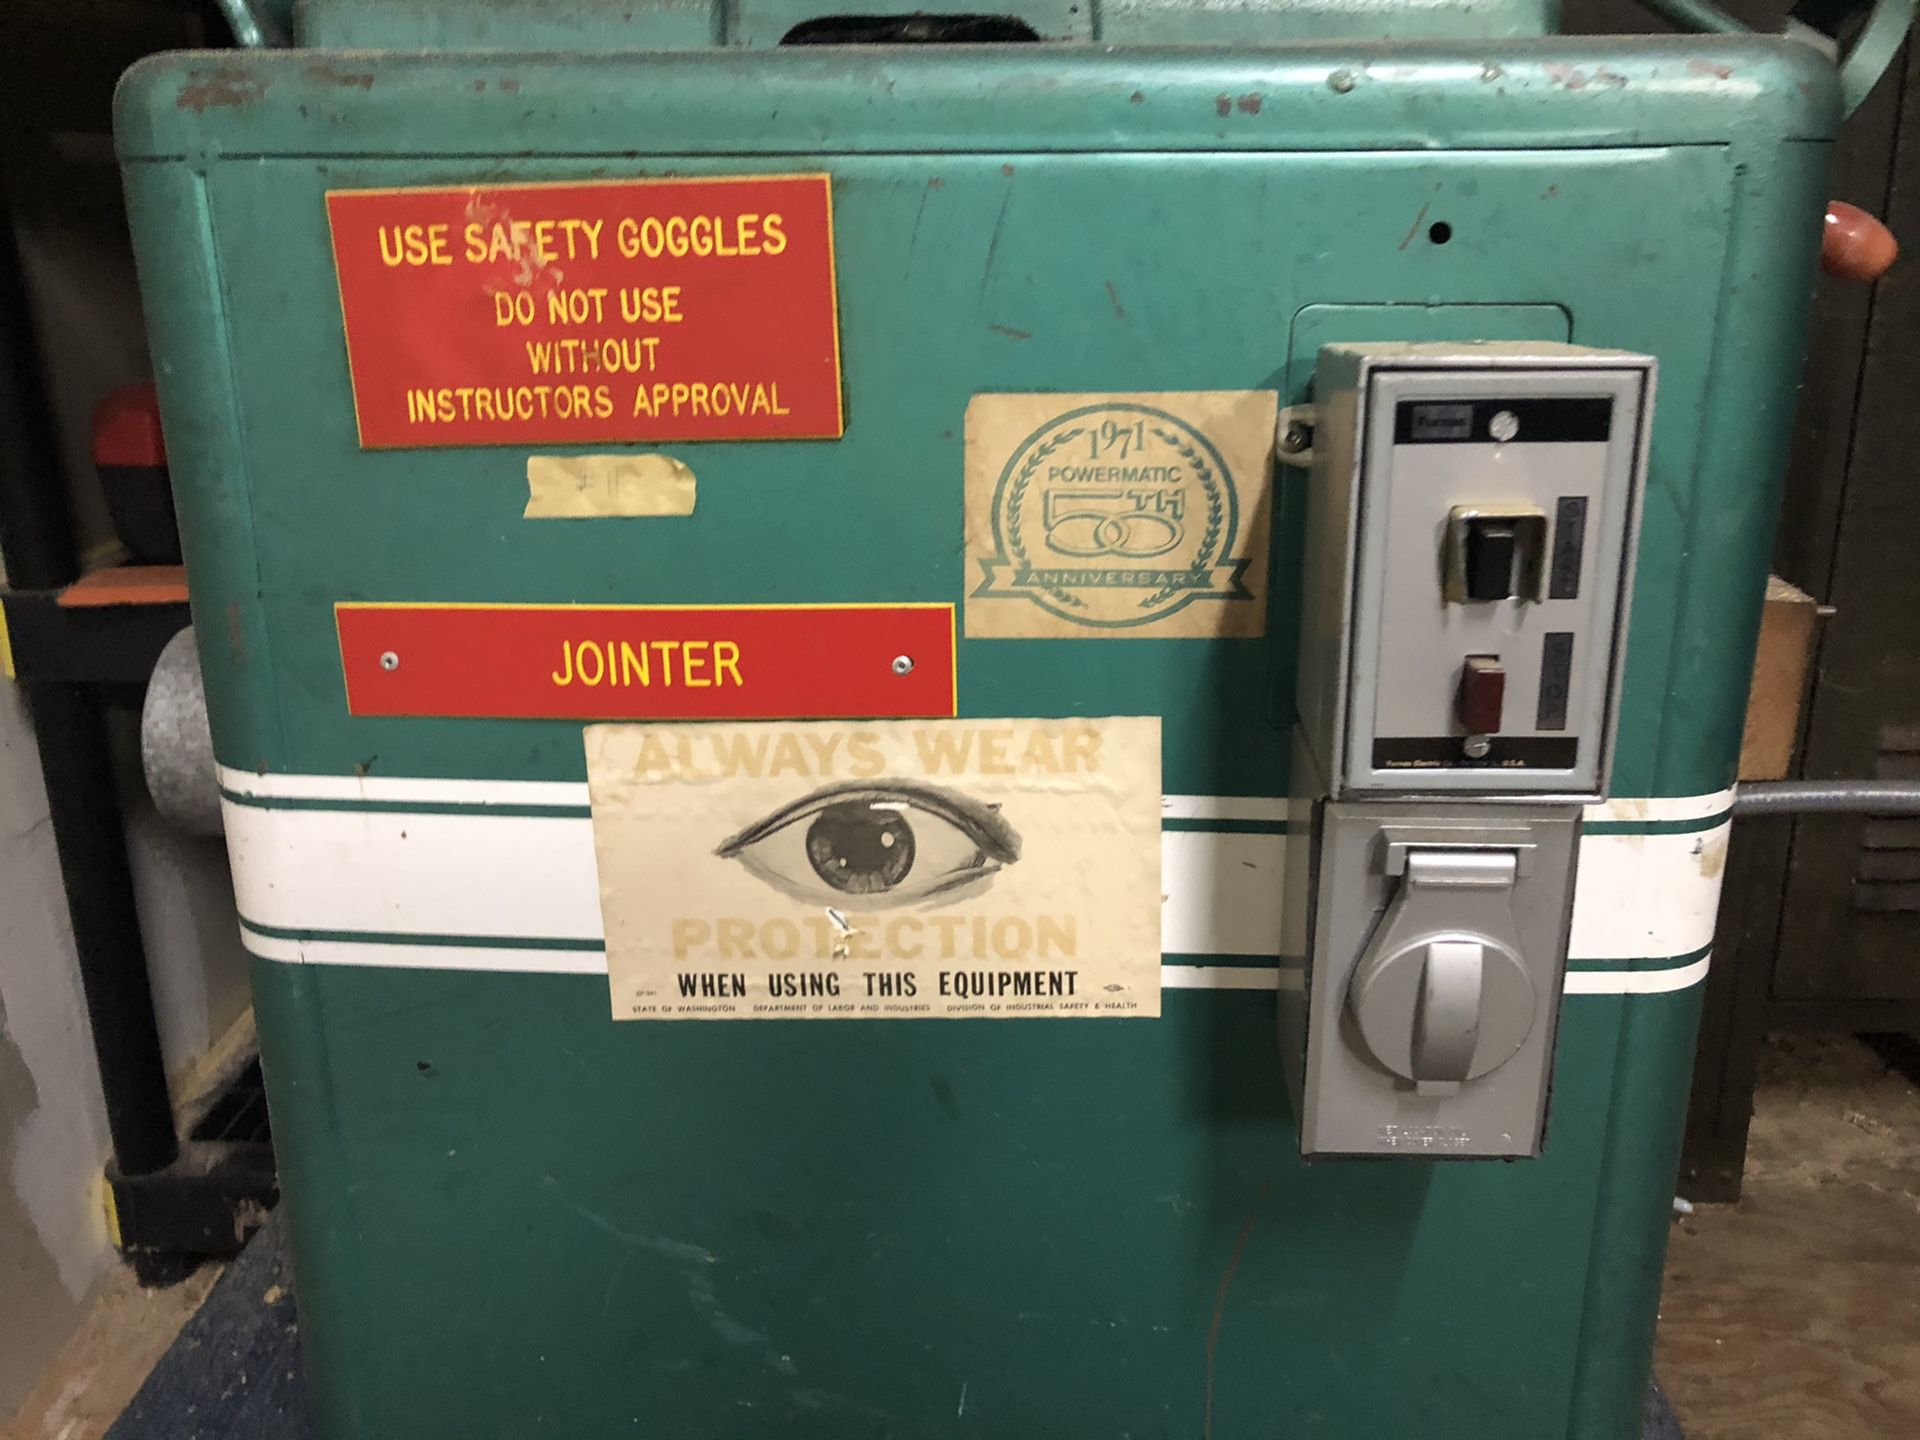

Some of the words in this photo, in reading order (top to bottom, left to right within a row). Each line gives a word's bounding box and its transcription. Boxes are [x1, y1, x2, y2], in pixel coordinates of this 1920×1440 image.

[378, 225, 452, 267] USE
[465, 217, 603, 262] SAFETY
[617, 214, 788, 258] GOGGLES
[495, 290, 535, 326] DO
[548, 289, 607, 325] NOT
[620, 287, 683, 322] USE
[526, 337, 660, 375] WITHOUT
[407, 386, 614, 424] INSTRUCTORS
[632, 382, 791, 418] APPROVAL
[1086, 418, 1146, 460] 1971
[1048, 464, 1183, 484] POWERMATIC
[1026, 571, 1202, 585] ANNIVERSARY
[551, 640, 744, 687] JOINTER
[634, 733, 887, 779] ALWAYS
[913, 731, 1105, 776] WEAR
[671, 915, 1077, 962] PROTECTION
[678, 973, 747, 997] WHEN
[768, 973, 841, 997] USING
[862, 972, 917, 997] THIS
[939, 971, 1079, 998] EQUIPMENT
[632, 1005, 657, 1013] STATE
[661, 1005, 672, 1013] OF
[753, 1004, 807, 1012] DEPARTMENT
[812, 1004, 823, 1012] OF
[828, 1004, 855, 1012] LABOR
[860, 1004, 879, 1012] AND
[884, 1004, 931, 1012] INDUSTRIES
[947, 1004, 985, 1012] DIVISION
[990, 1004, 1001, 1012] OF
[1006, 1003, 1054, 1011] INDUSTRIAL
[1059, 1003, 1089, 1011] SAFETY
[1105, 1002, 1137, 1010] HEALTH
